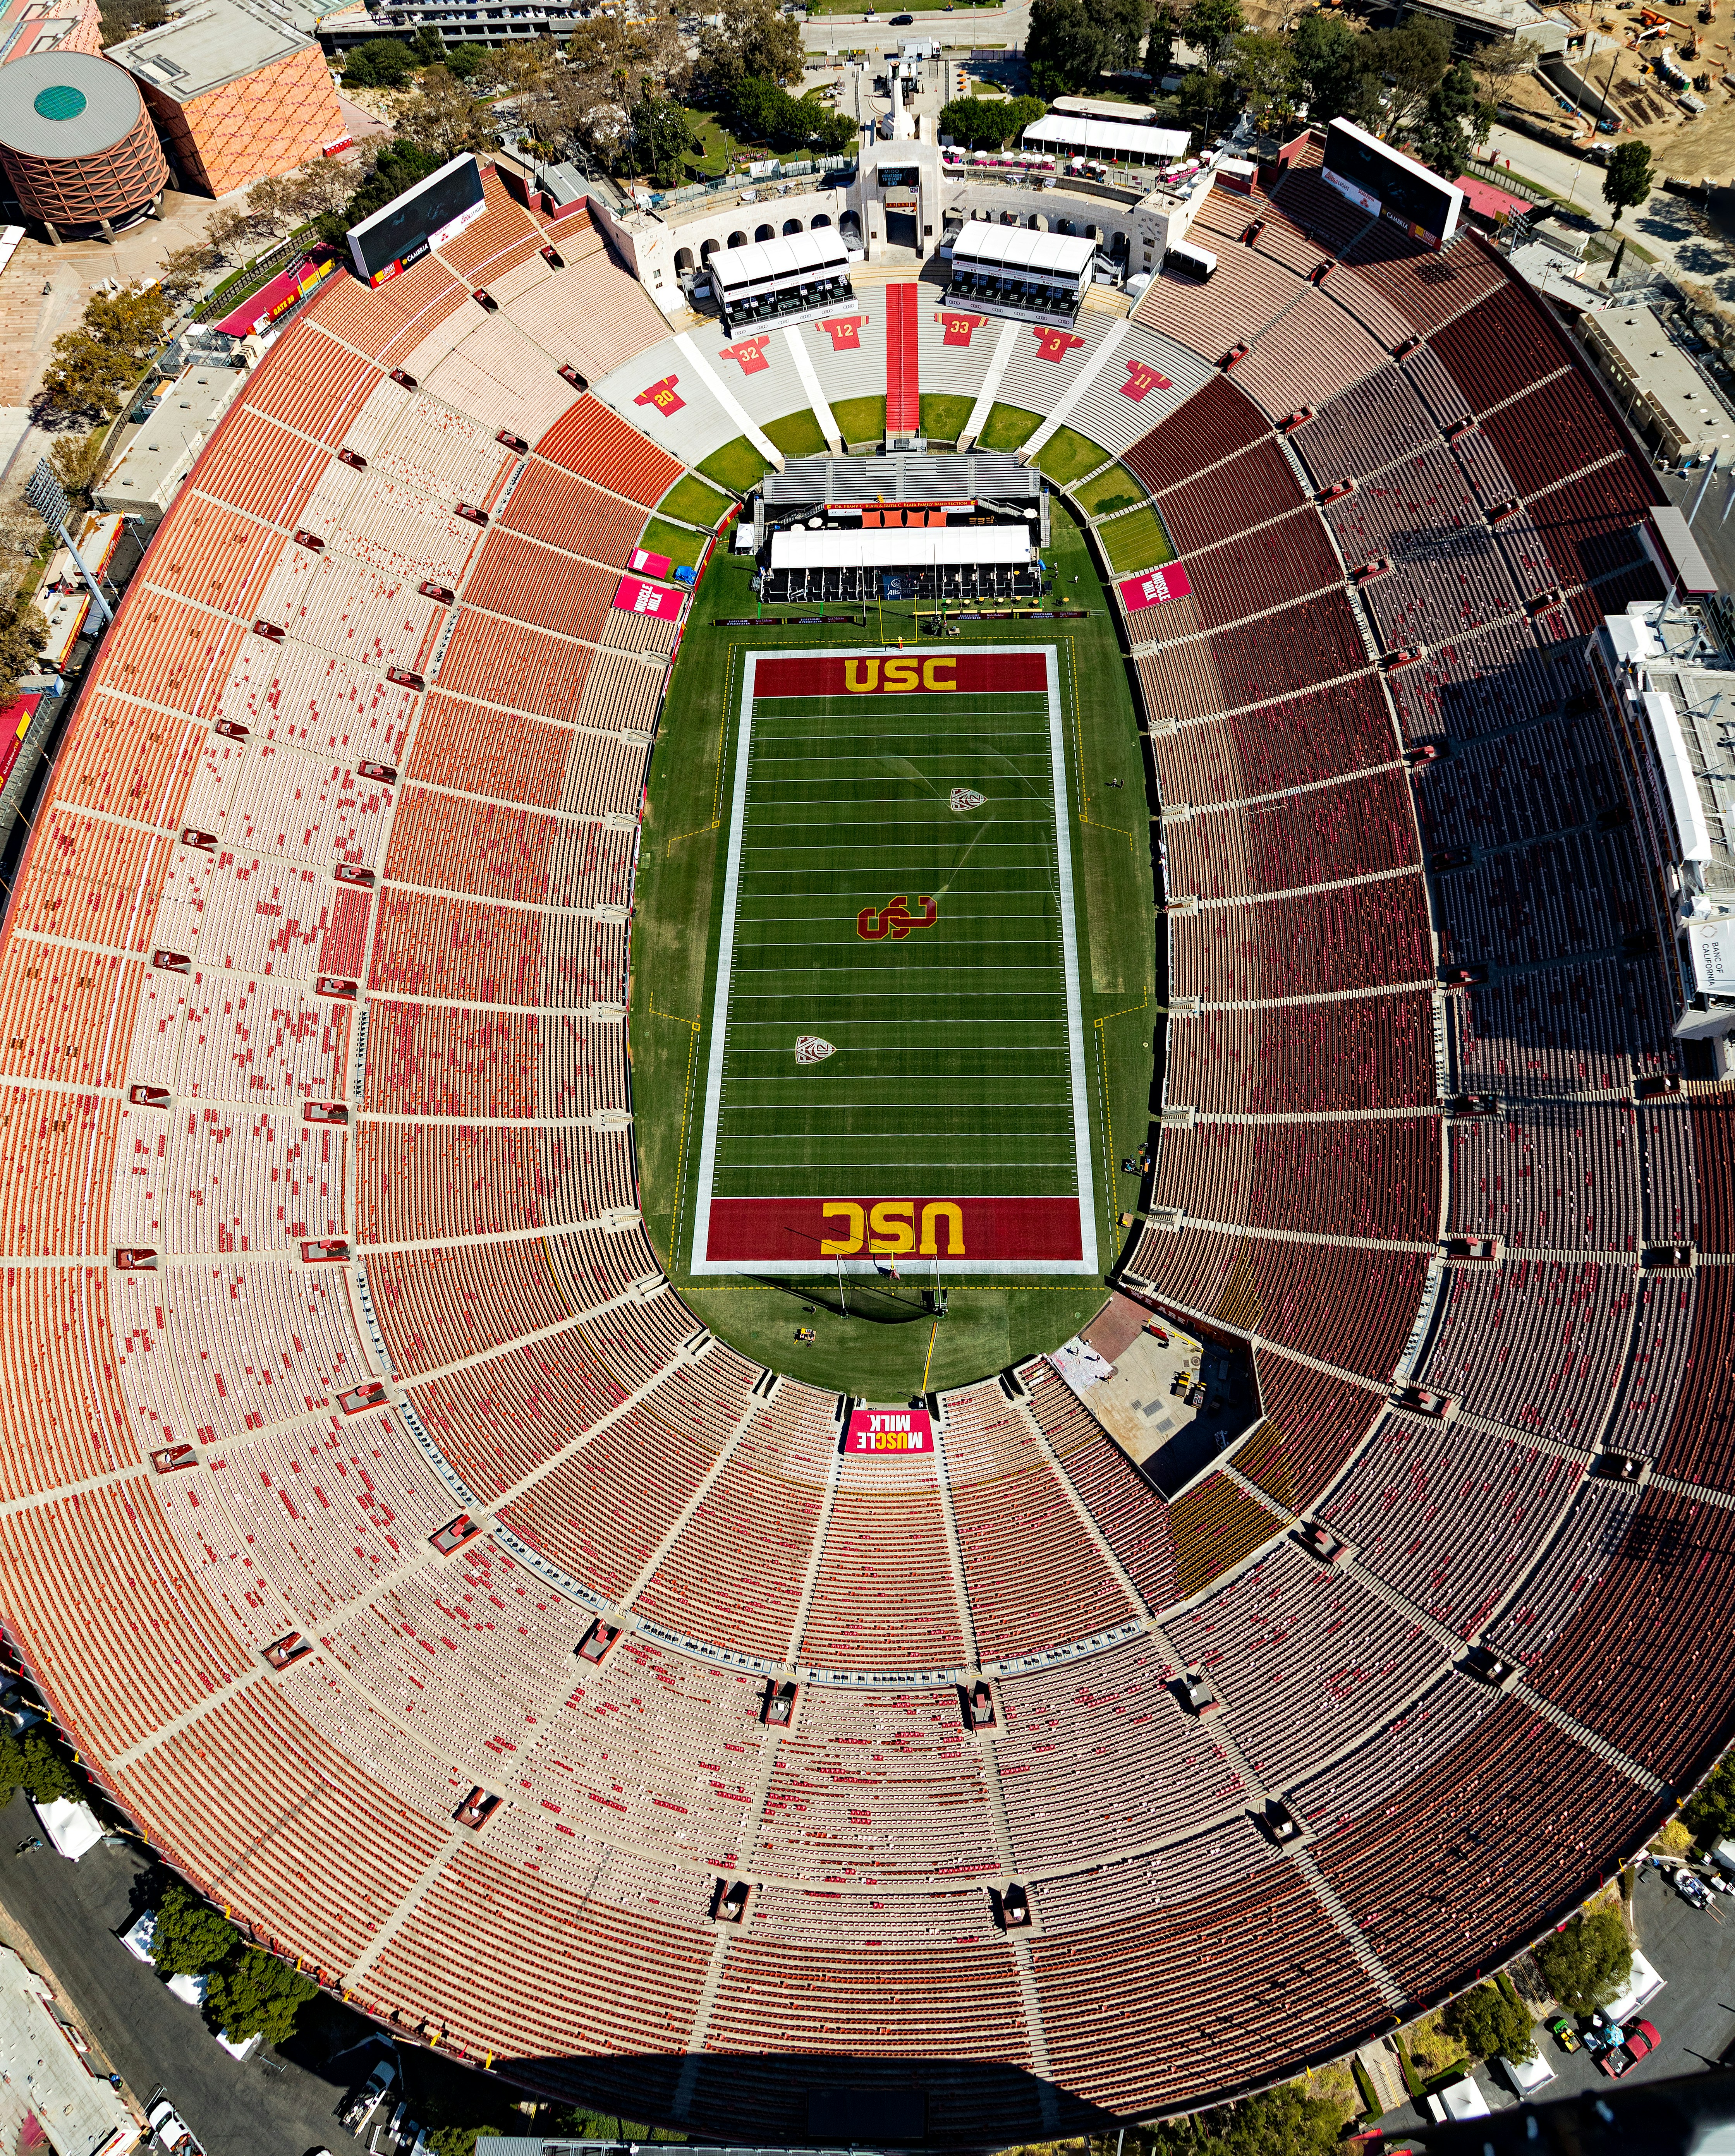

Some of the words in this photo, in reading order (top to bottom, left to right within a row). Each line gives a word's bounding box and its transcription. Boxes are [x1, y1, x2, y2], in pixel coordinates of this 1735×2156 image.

[1338, 180, 1350, 192] LIGHT
[472, 204, 484, 216] LIGHT
[1386, 212, 1409, 230] CAMBRIA
[1422, 232, 1435, 244] UNION
[407, 244, 429, 262] CAMBRIA
[273, 300, 287, 316] GATE
[836, 324, 853, 338] 12
[950, 321, 969, 333] 33
[1050, 338, 1060, 350] 3
[739, 347, 760, 361] 32
[1134, 374, 1151, 389] 11
[654, 390, 674, 407] 20
[1151, 571, 1171, 602] MUSCLE
[633, 584, 653, 613] MUSCLE
[845, 657, 957, 692] USC
[1642, 754, 1656, 788] TROJAN
[1649, 786, 1667, 829] FOOTBALL
[1634, 775, 1650, 816] NATIONAL
[1643, 816, 1663, 867] CHAMPIONS
[1712, 942, 1721, 962] BANC
[1702, 944, 1715, 986] CALIFORNIA
[1716, 964, 1723, 973] OF
[821, 1202, 965, 1255] USC
[1130, 1290, 1153, 1305] WE
[1157, 1306, 1185, 1324] ARE
[857, 1432, 922, 1449] MUSCLE
